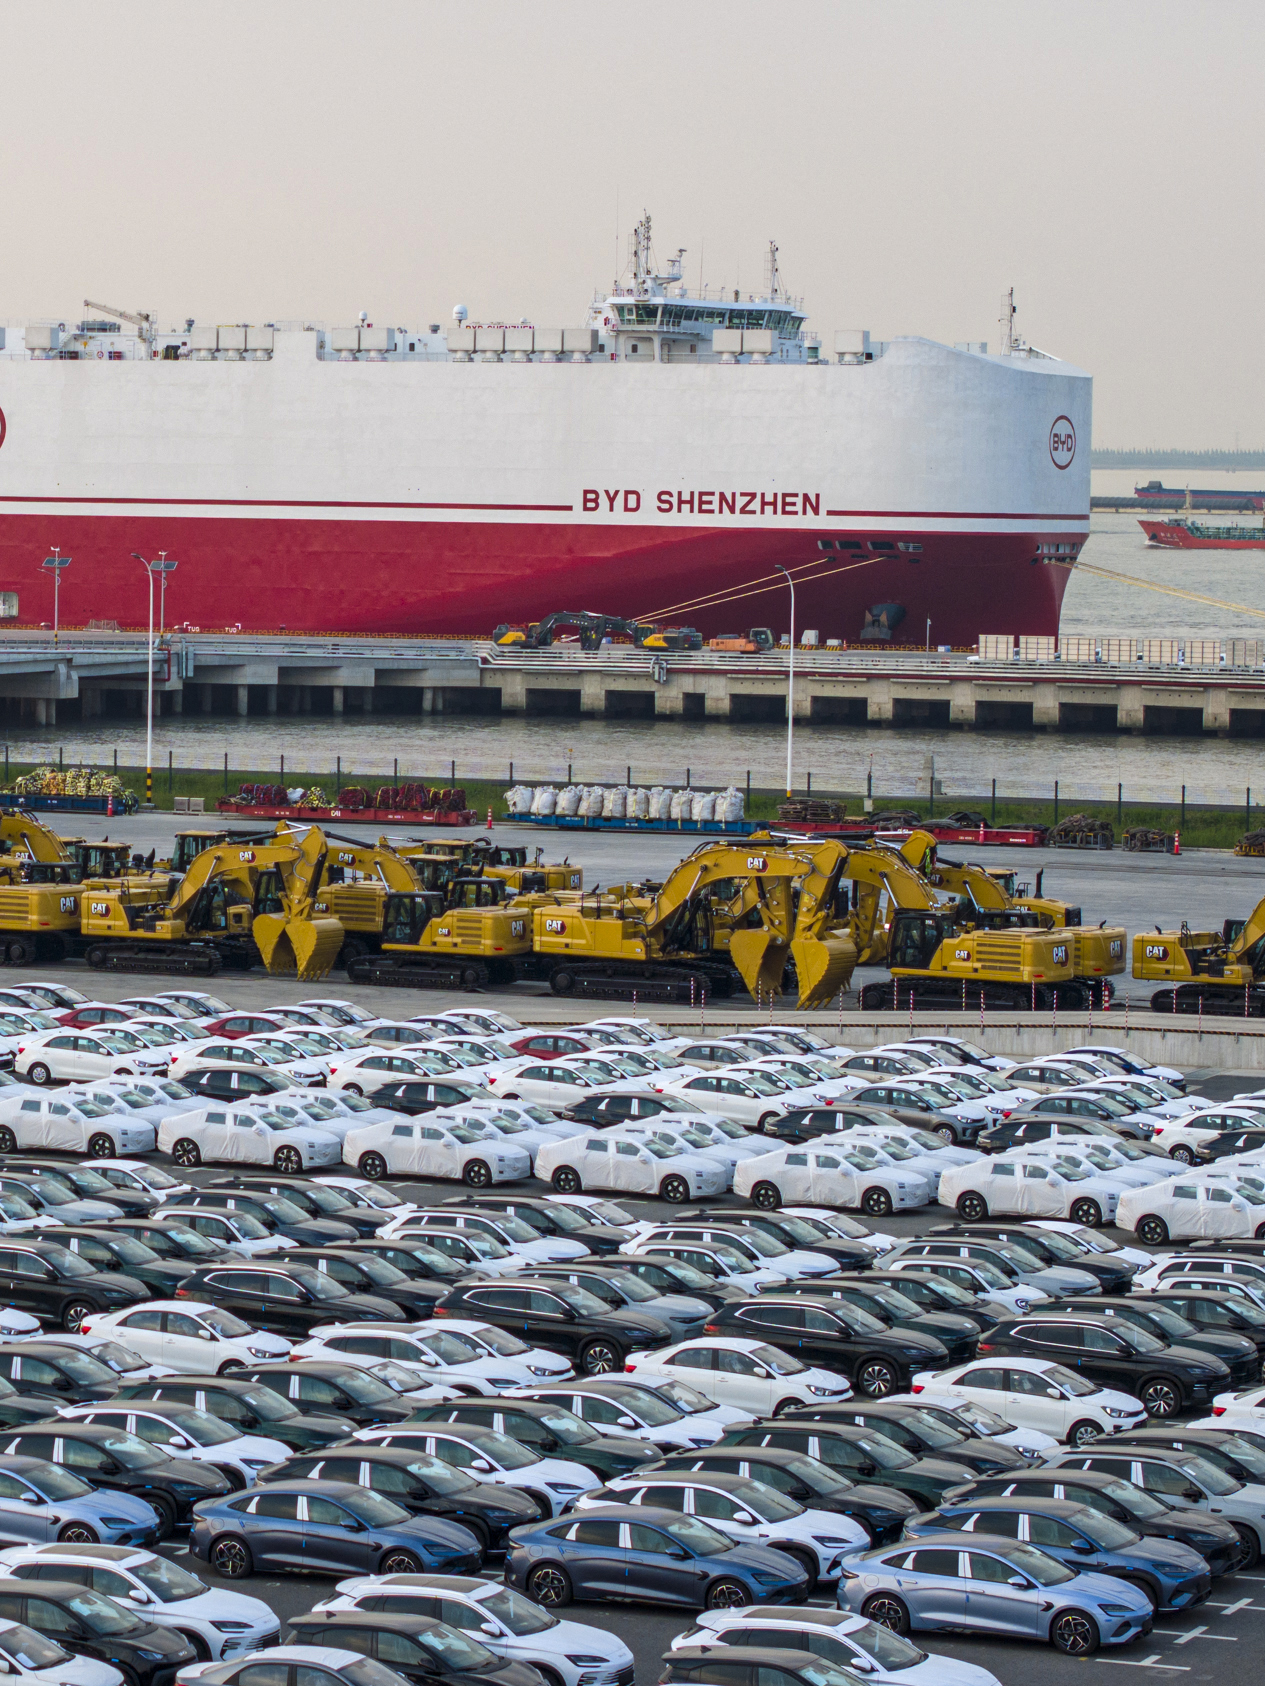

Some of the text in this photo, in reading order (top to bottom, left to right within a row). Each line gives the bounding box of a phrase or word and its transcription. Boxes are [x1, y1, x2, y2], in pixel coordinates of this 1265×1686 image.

[1052, 433, 1073, 452] BYD
[583, 490, 821, 516] BYD SHENZHEN
[239, 852, 252, 862] CAT
[339, 852, 353, 864] CAT
[747, 858, 764, 869] CAT
[929, 874, 940, 884] AT
[60, 897, 74, 912] CAT
[92, 903, 106, 914] CAT
[315, 903, 327, 911] CAT
[511, 920, 523, 936] CAT
[546, 920, 562, 932] CAT
[955, 950, 968, 959] CAT
[1053, 946, 1065, 962] CAT
[1110, 941, 1120, 957] CAT
[1146, 946, 1164, 957] CAT
